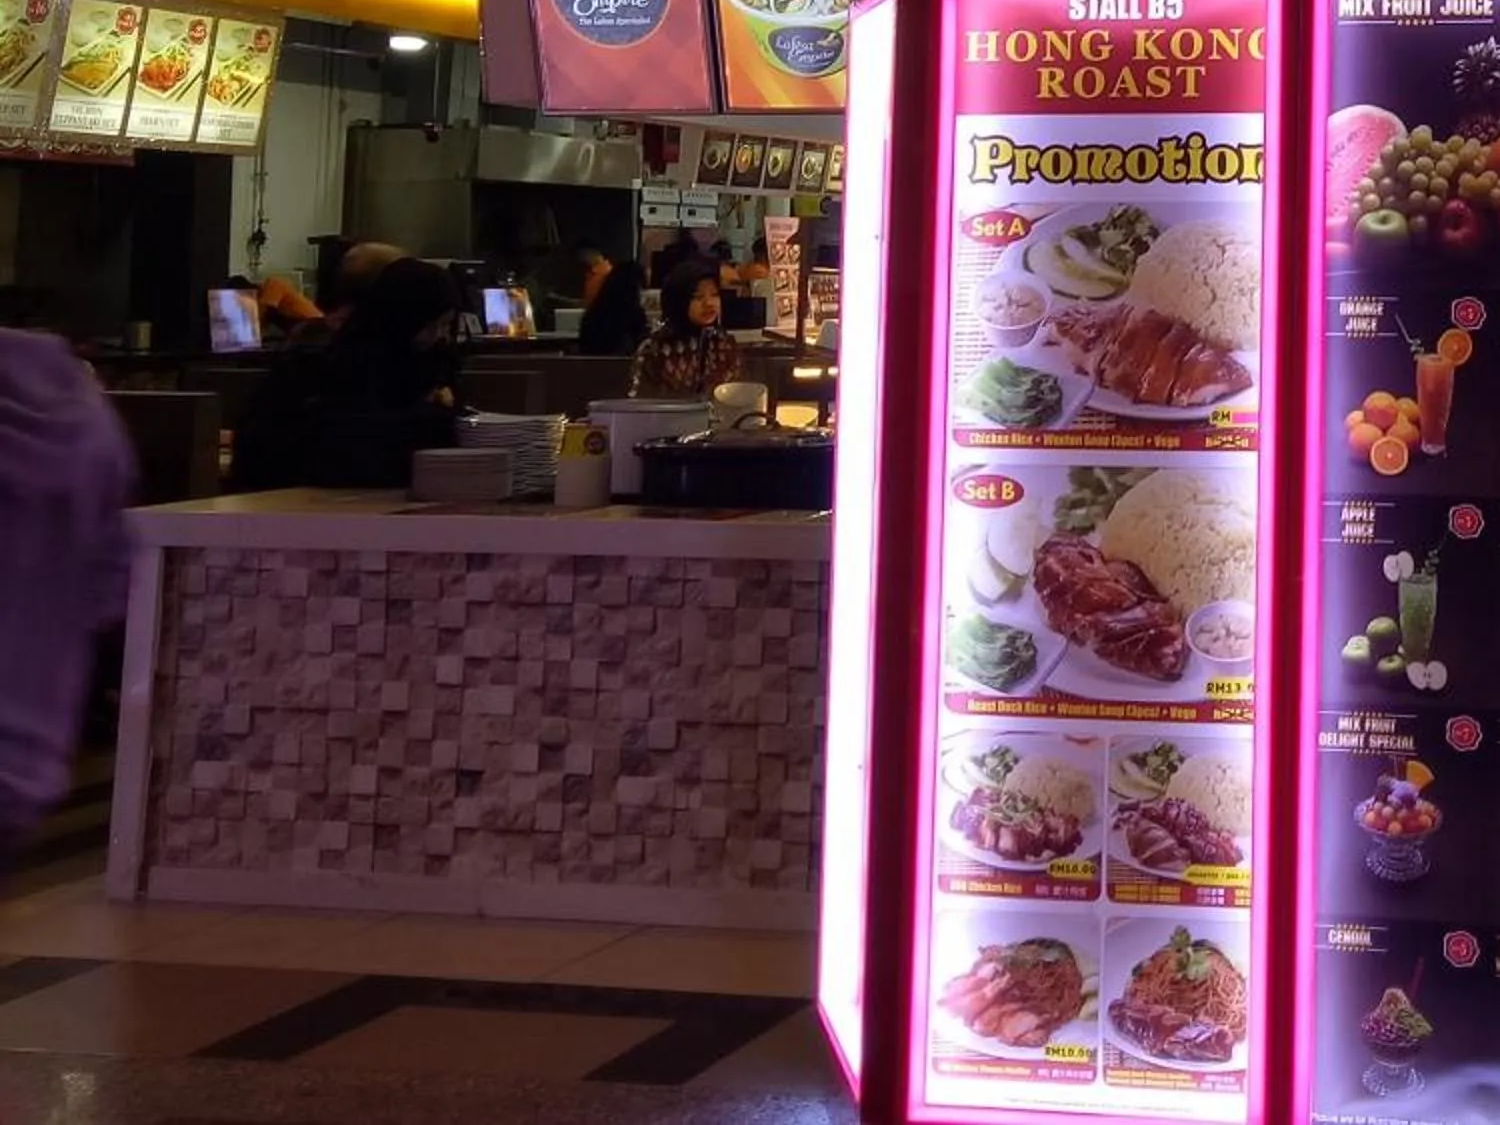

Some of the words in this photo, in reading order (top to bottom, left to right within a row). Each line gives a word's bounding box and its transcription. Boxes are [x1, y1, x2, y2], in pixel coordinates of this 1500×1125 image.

[963, 29, 1114, 64] HONG
[1035, 65, 1207, 100] ROAST
[970, 217, 1008, 236] Set
[1010, 218, 1026, 236] A
[1339, 301, 1384, 316] ORANGE
[1345, 317, 1378, 332] JUICE
[961, 480, 1000, 499] Set
[1002, 482, 1016, 499] B
[1341, 506, 1376, 521] APPLE
[1341, 522, 1375, 539] JUICE
[1338, 715, 1362, 730] MIX
[1365, 717, 1397, 732] FRUIT
[1318, 731, 1367, 747] DELIGHT
[1369, 734, 1416, 750] SPECIAL
